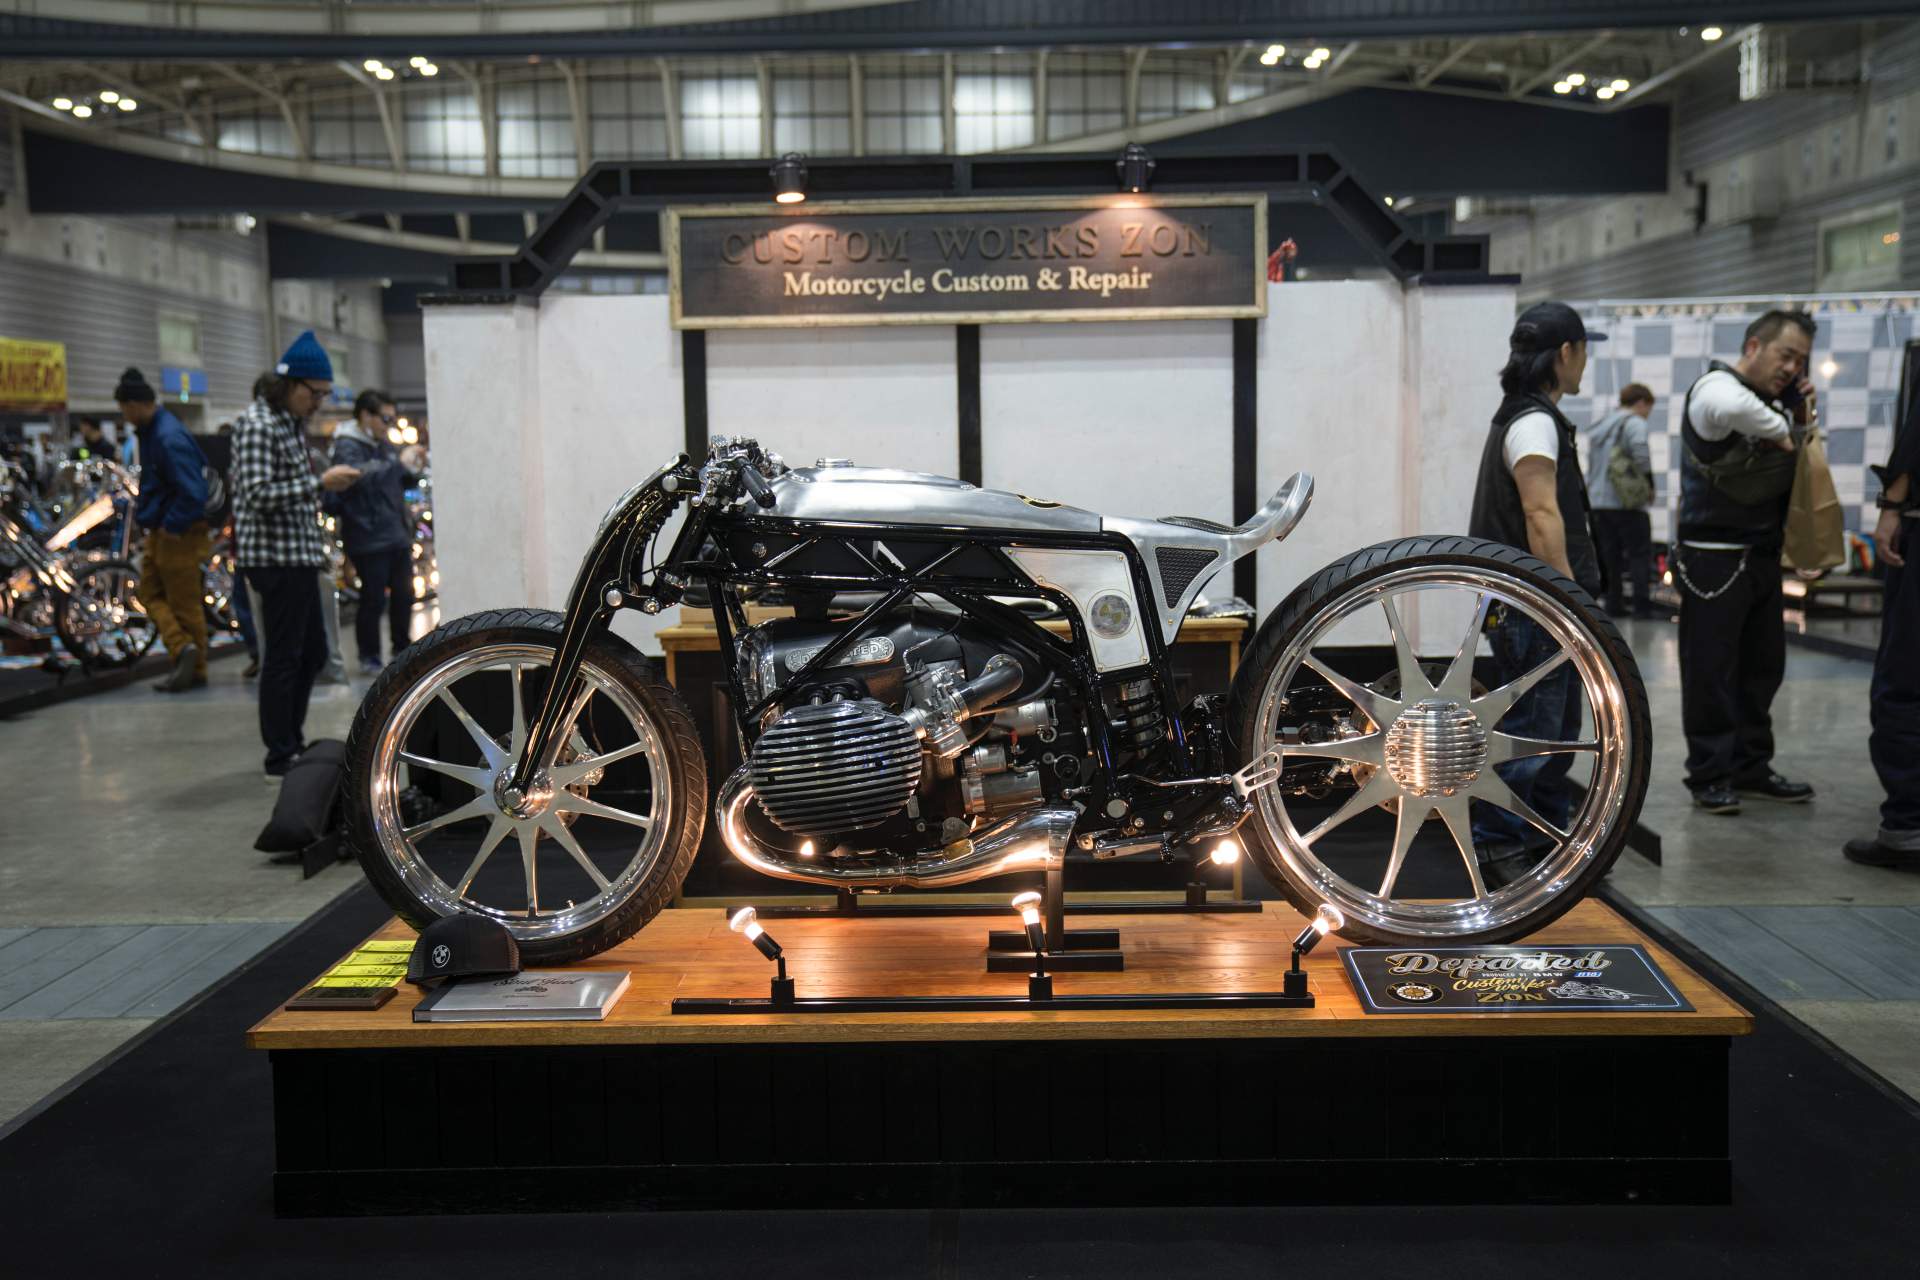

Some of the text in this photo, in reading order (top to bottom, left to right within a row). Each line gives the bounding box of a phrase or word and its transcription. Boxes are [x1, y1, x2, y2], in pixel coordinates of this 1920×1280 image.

[721, 222, 1213, 266] CUSTOM WORKS ZON
[784, 266, 1152, 300] Motorcycle Custom & Repair
[1386, 951, 1612, 979] Departed
[1452, 977, 1526, 991] Custom
[1476, 992, 1547, 1002] ZON
